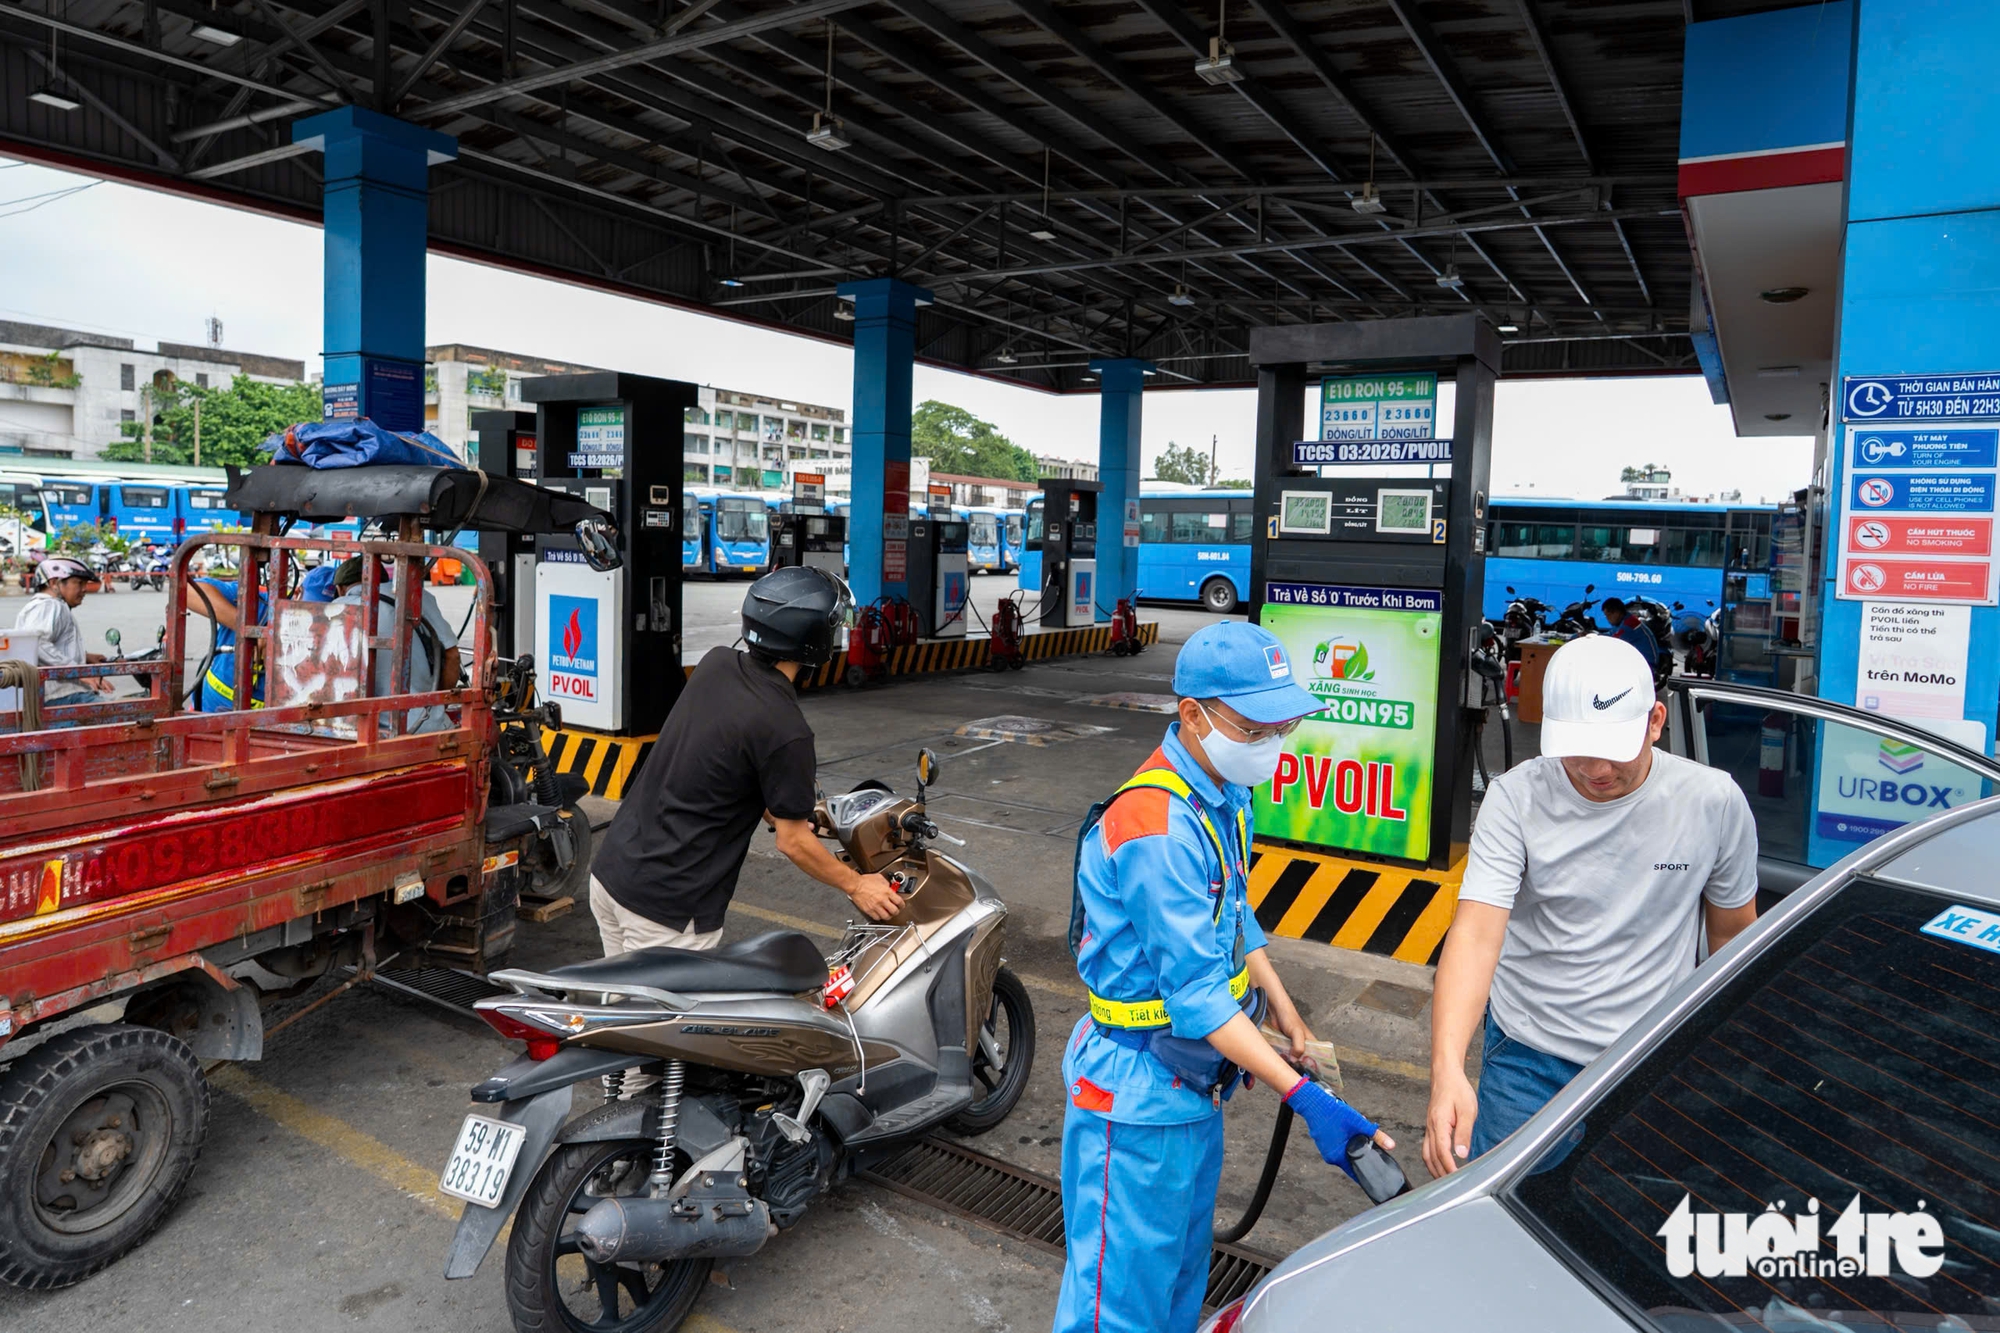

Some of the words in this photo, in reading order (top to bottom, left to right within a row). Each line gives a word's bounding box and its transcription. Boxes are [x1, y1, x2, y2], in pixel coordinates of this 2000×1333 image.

[1329, 383, 1351, 399] E10
[1355, 383, 1383, 397] RON
[1387, 381, 1404, 396] 95
[1415, 380, 1429, 396] III
[1900, 380, 1923, 393] THỜI
[1925, 382, 1950, 392] GIAN
[1953, 378, 1974, 392] BÁN
[1325, 410, 1368, 421] 23660
[1385, 408, 1430, 420] 23660
[1898, 397, 1914, 416] TỪ
[1916, 400, 1943, 415] 5H30
[1945, 396, 1969, 415] ĐẾN
[1298, 445, 1335, 460] TCCS
[1338, 442, 1452, 460] 03:2026/PVOIL
[570, 455, 586, 466] TCCS
[1269, 519, 1277, 537] 1
[1435, 522, 1445, 541] 2
[1273, 588, 1291, 601] Trả
[1294, 587, 1308, 602] Về
[1311, 590, 1327, 603] Số
[1343, 592, 1379, 606] Trước
[1382, 594, 1402, 607] Khi
[1405, 596, 1435, 609] Bơm
[1871, 616, 1899, 624] PVOIL
[1867, 670, 1899, 681] trên
[1903, 671, 1956, 686] MoMo
[1308, 680, 1341, 694] XĂNG
[1342, 687, 1360, 696] SINH
[1361, 689, 1377, 699] HỌC
[1272, 752, 1406, 822] PVOIL
[1838, 776, 1953, 809] URBOX
[1850, 825, 1869, 834] 1900
[1654, 863, 1690, 871] SPORT
[1933, 912, 1982, 935] XE
[1976, 923, 2000, 949] H
[1153, 1007, 1170, 1021] kiệ
[445, 1155, 505, 1201] 383.19
